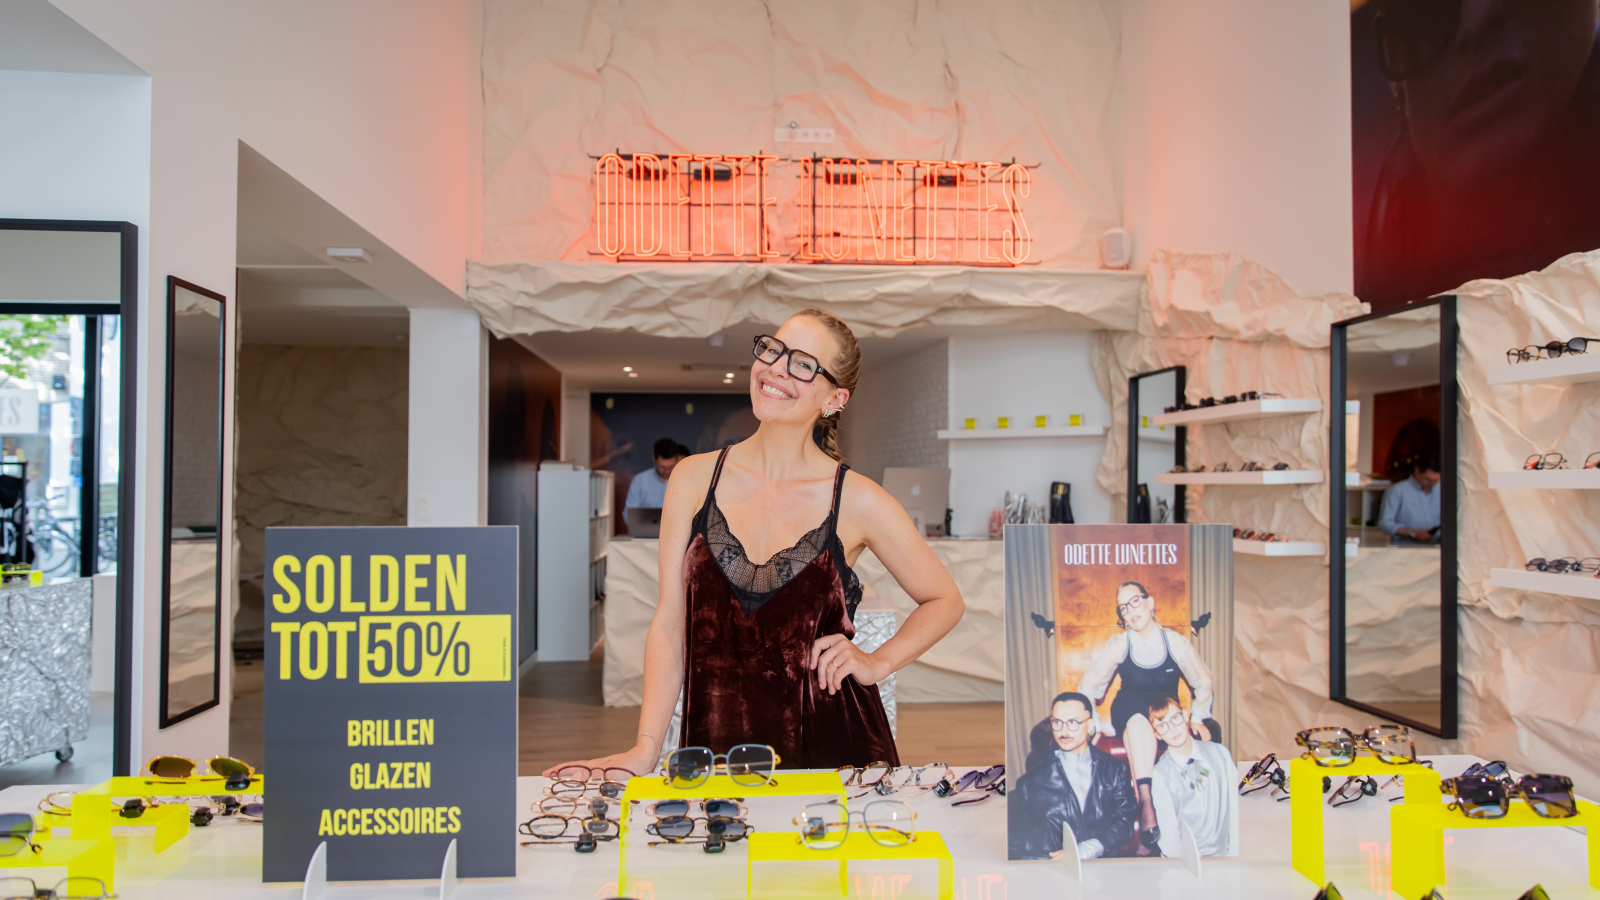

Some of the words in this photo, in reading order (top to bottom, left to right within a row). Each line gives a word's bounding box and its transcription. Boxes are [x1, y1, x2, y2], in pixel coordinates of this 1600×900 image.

[596, 153, 781, 258] ODETTE
[799, 157, 1031, 265] LUNETTES
[1064, 544, 1112, 565] ODETTE
[1115, 544, 1177, 565] LUNETTES
[272, 554, 466, 613] SOLDEN
[271, 621, 357, 680] TOT
[366, 621, 471, 678] 50%
[347, 719, 434, 746] BRILLEN
[349, 761, 432, 790] GLAZEN
[318, 806, 462, 836] ACCESSOIRES
